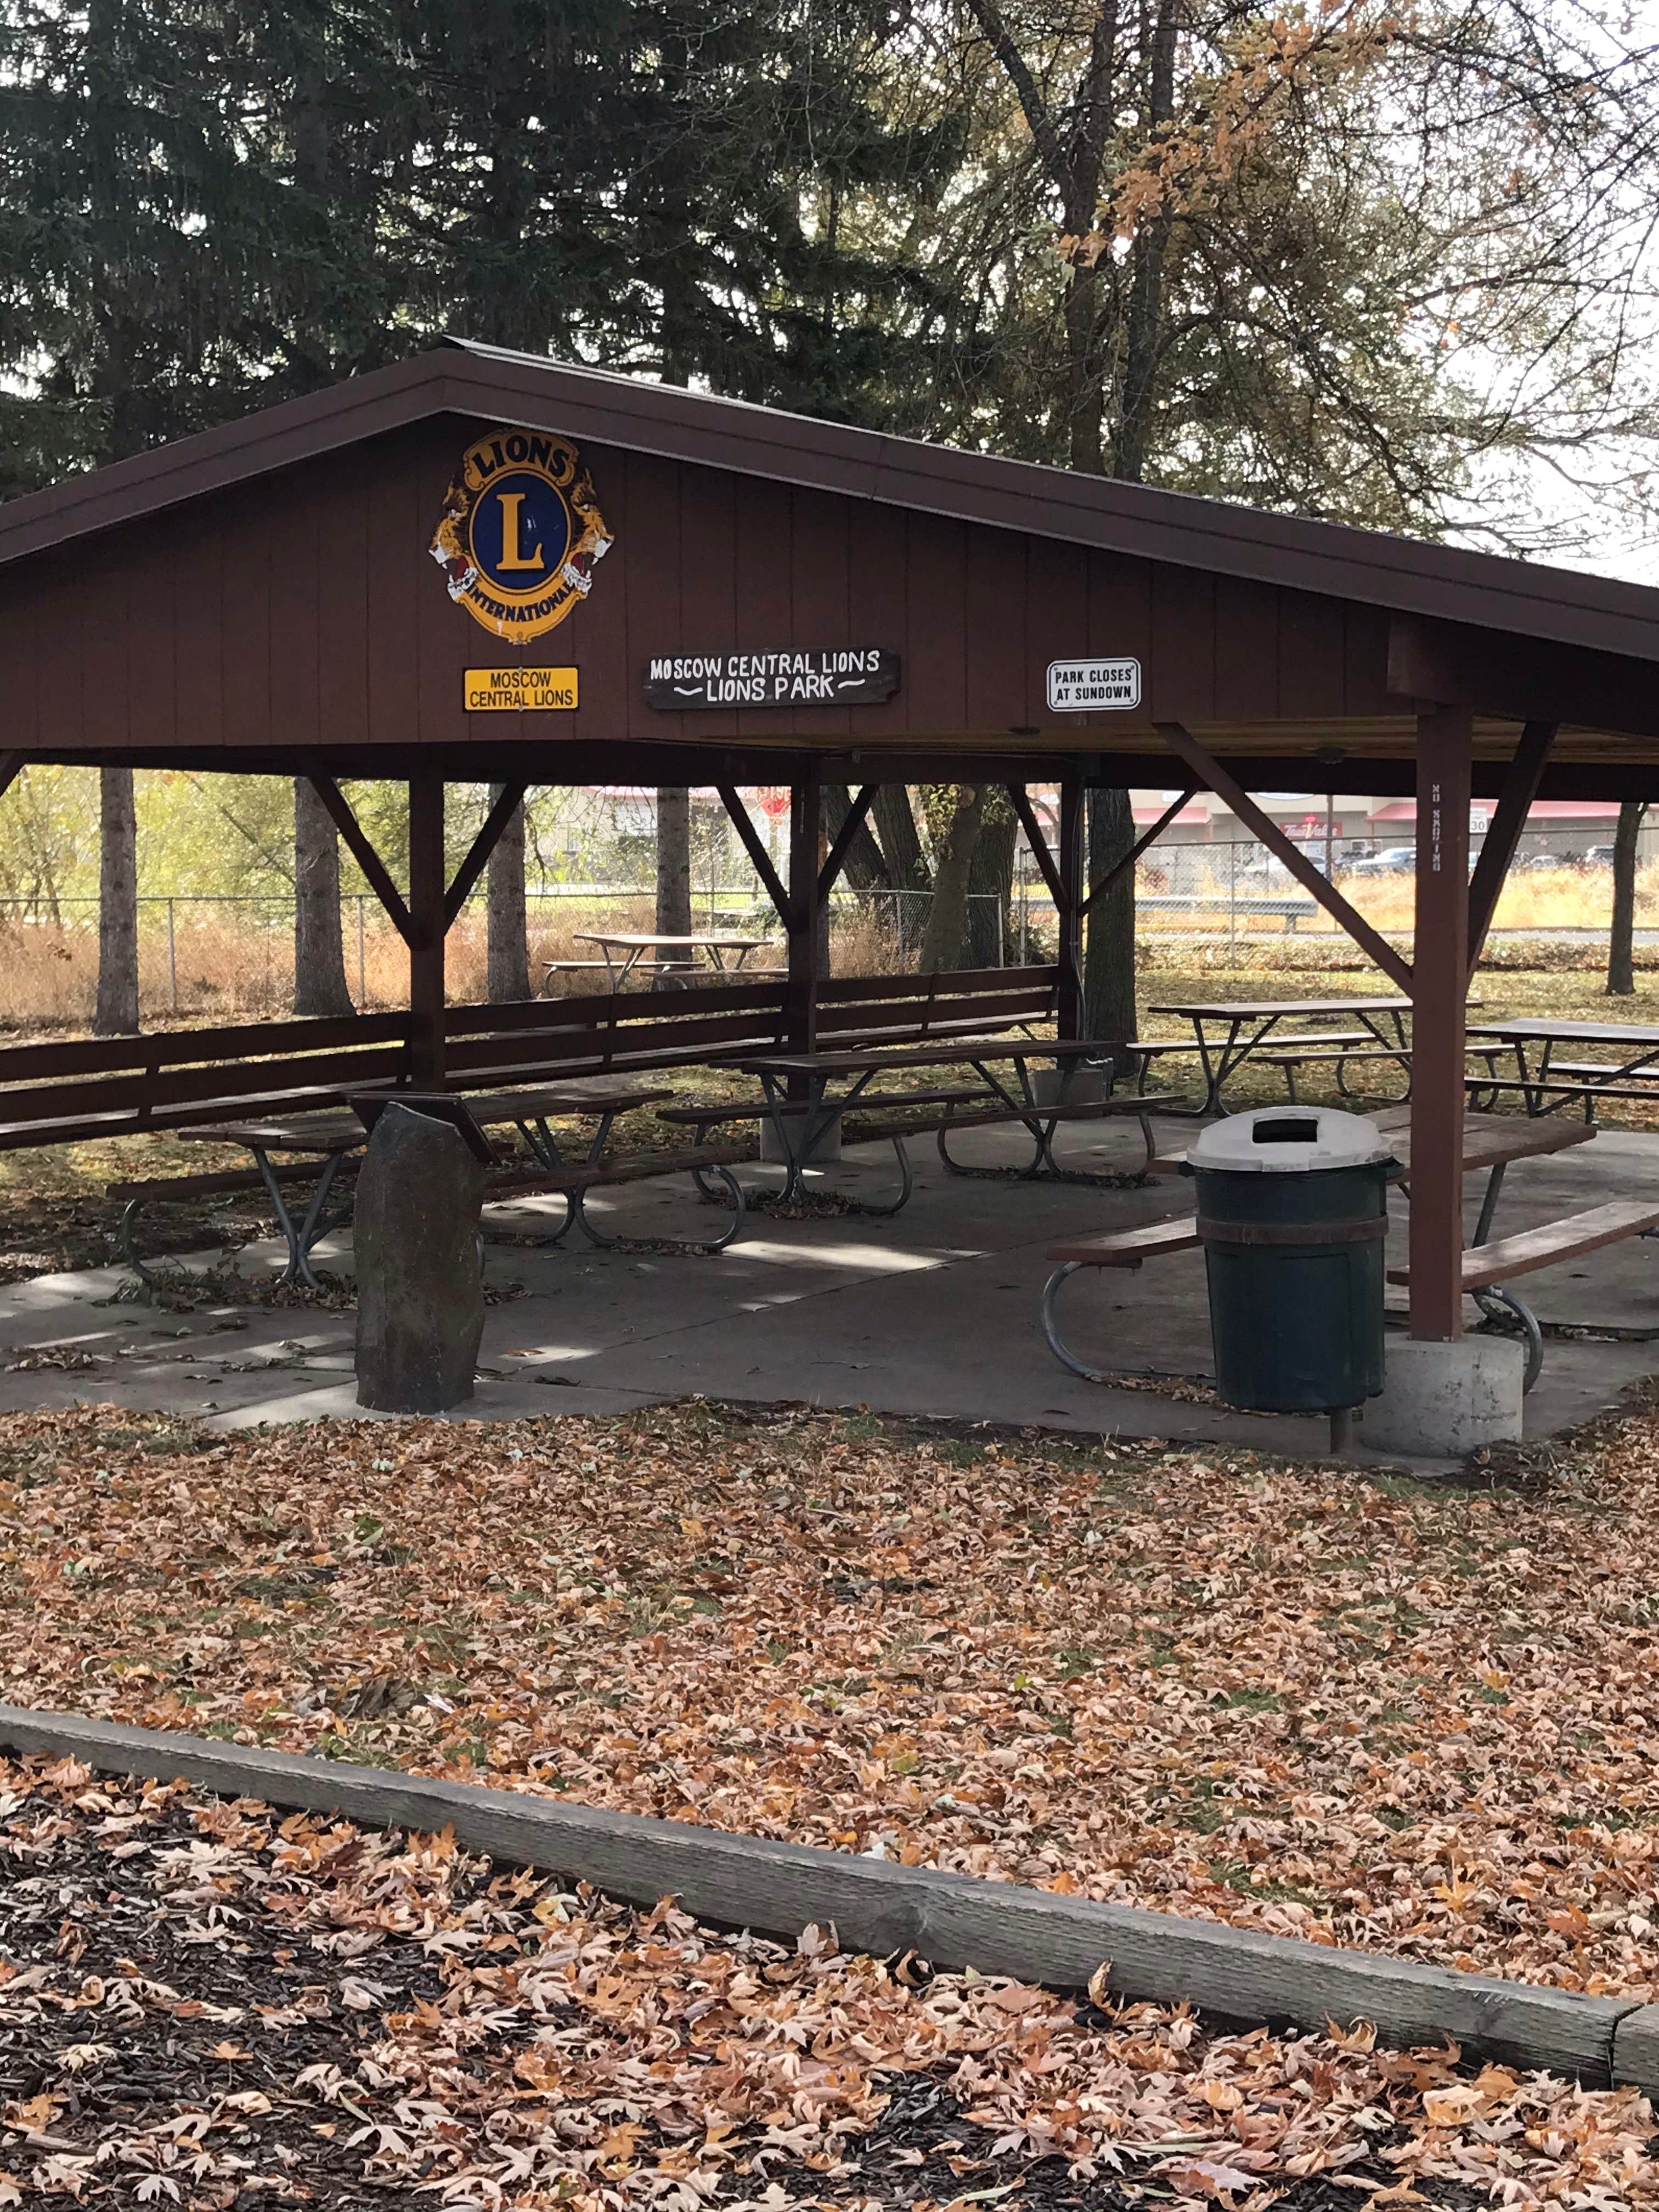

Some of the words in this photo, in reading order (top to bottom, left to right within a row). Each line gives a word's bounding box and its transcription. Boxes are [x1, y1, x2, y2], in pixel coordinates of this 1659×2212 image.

[472, 435, 569, 478] LIONS
[496, 493, 545, 570] L
[464, 581, 575, 622] INTERNATIONAL
[650, 657, 722, 680] MOSCOW
[727, 653, 815, 678] CENTRAL
[822, 650, 880, 674] LIONS
[490, 672, 551, 688] MOSCOW
[1055, 670, 1084, 684] PARK
[1089, 669, 1132, 682] CLOSES
[470, 691, 529, 707] CENTRAL
[534, 689, 573, 706] LIONS
[707, 676, 766, 702] LIONS
[775, 675, 834, 699] PARK
[1057, 688, 1070, 701] AT
[1075, 686, 1131, 700] SUNDOWN
[1432, 784, 1440, 803] NO
[1471, 821, 1485, 831] 30
